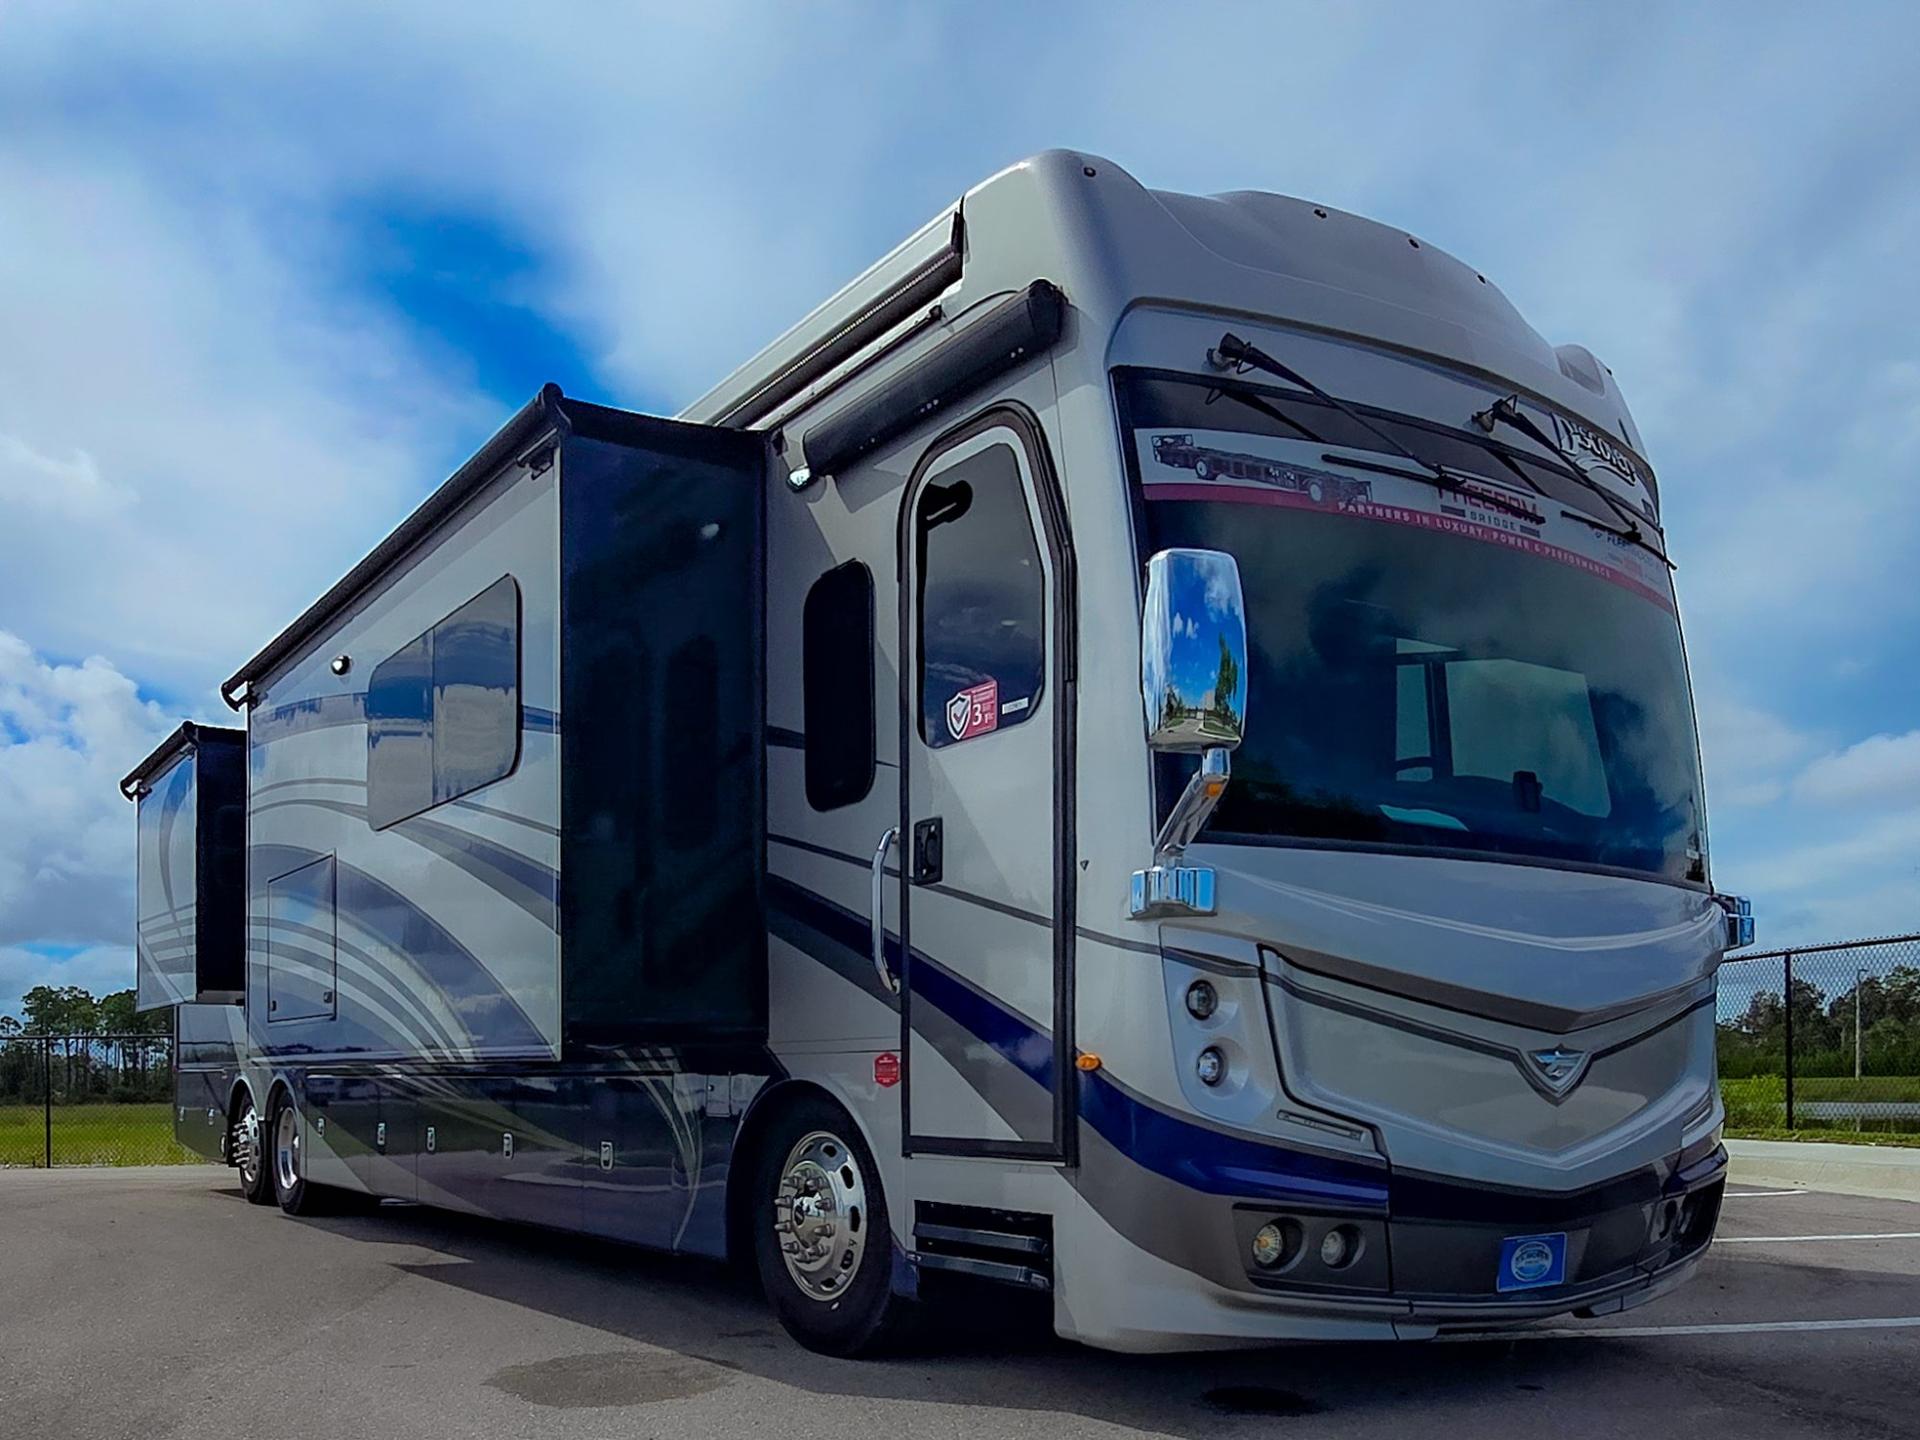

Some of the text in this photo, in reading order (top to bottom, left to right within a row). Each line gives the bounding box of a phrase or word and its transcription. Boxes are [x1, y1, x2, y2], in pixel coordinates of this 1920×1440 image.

[1470, 511, 1517, 531] BRIDGE
[1338, 501, 1410, 522] PARTNERS
[1416, 514, 1430, 526] IN
[1436, 518, 1488, 539] LUXURY,
[1492, 531, 1529, 550] POWER
[1544, 548, 1610, 578] PERFORMANCE
[972, 703, 982, 726] 3
